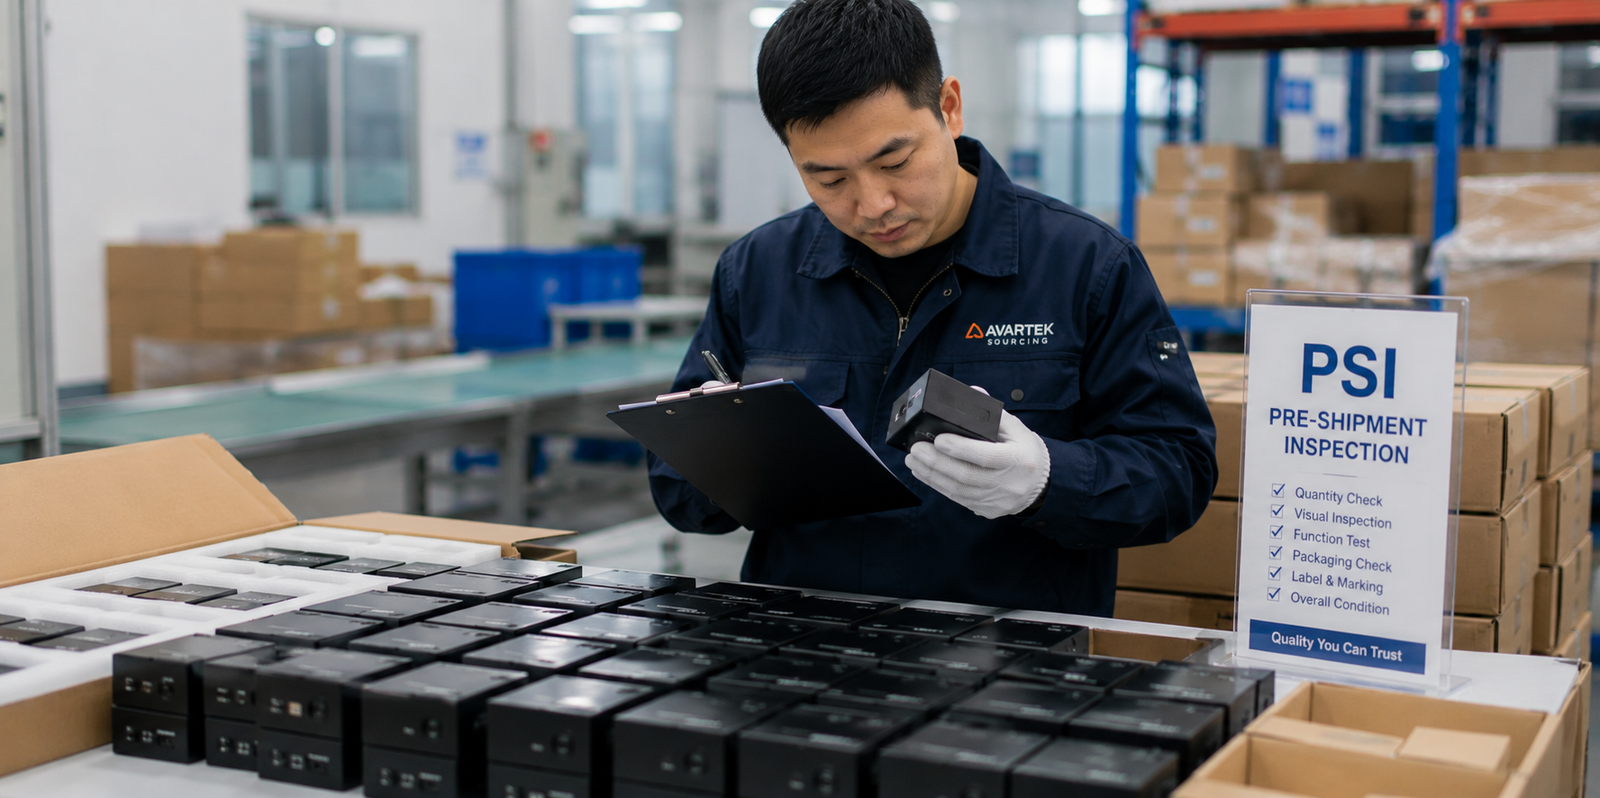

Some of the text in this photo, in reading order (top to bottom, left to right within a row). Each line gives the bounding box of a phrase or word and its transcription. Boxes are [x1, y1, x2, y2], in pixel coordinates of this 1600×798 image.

[985, 323, 1054, 337] AVARTEK
[987, 337, 1048, 346] SOURCING
[1302, 343, 1396, 399] PSI
[1269, 407, 1428, 437] PRE-SHIPMENT
[1284, 436, 1409, 464] INSPECTION
[1295, 487, 1383, 507] Quantity Check
[1294, 507, 1392, 529] Visual Inspection
[1294, 529, 1371, 549] Function Test
[1292, 550, 1392, 573] Packaging Check
[1292, 570, 1384, 596] Label & Marking
[1290, 592, 1390, 616] Overall Condition
[1271, 631, 1403, 662] Quality You Can Trust
